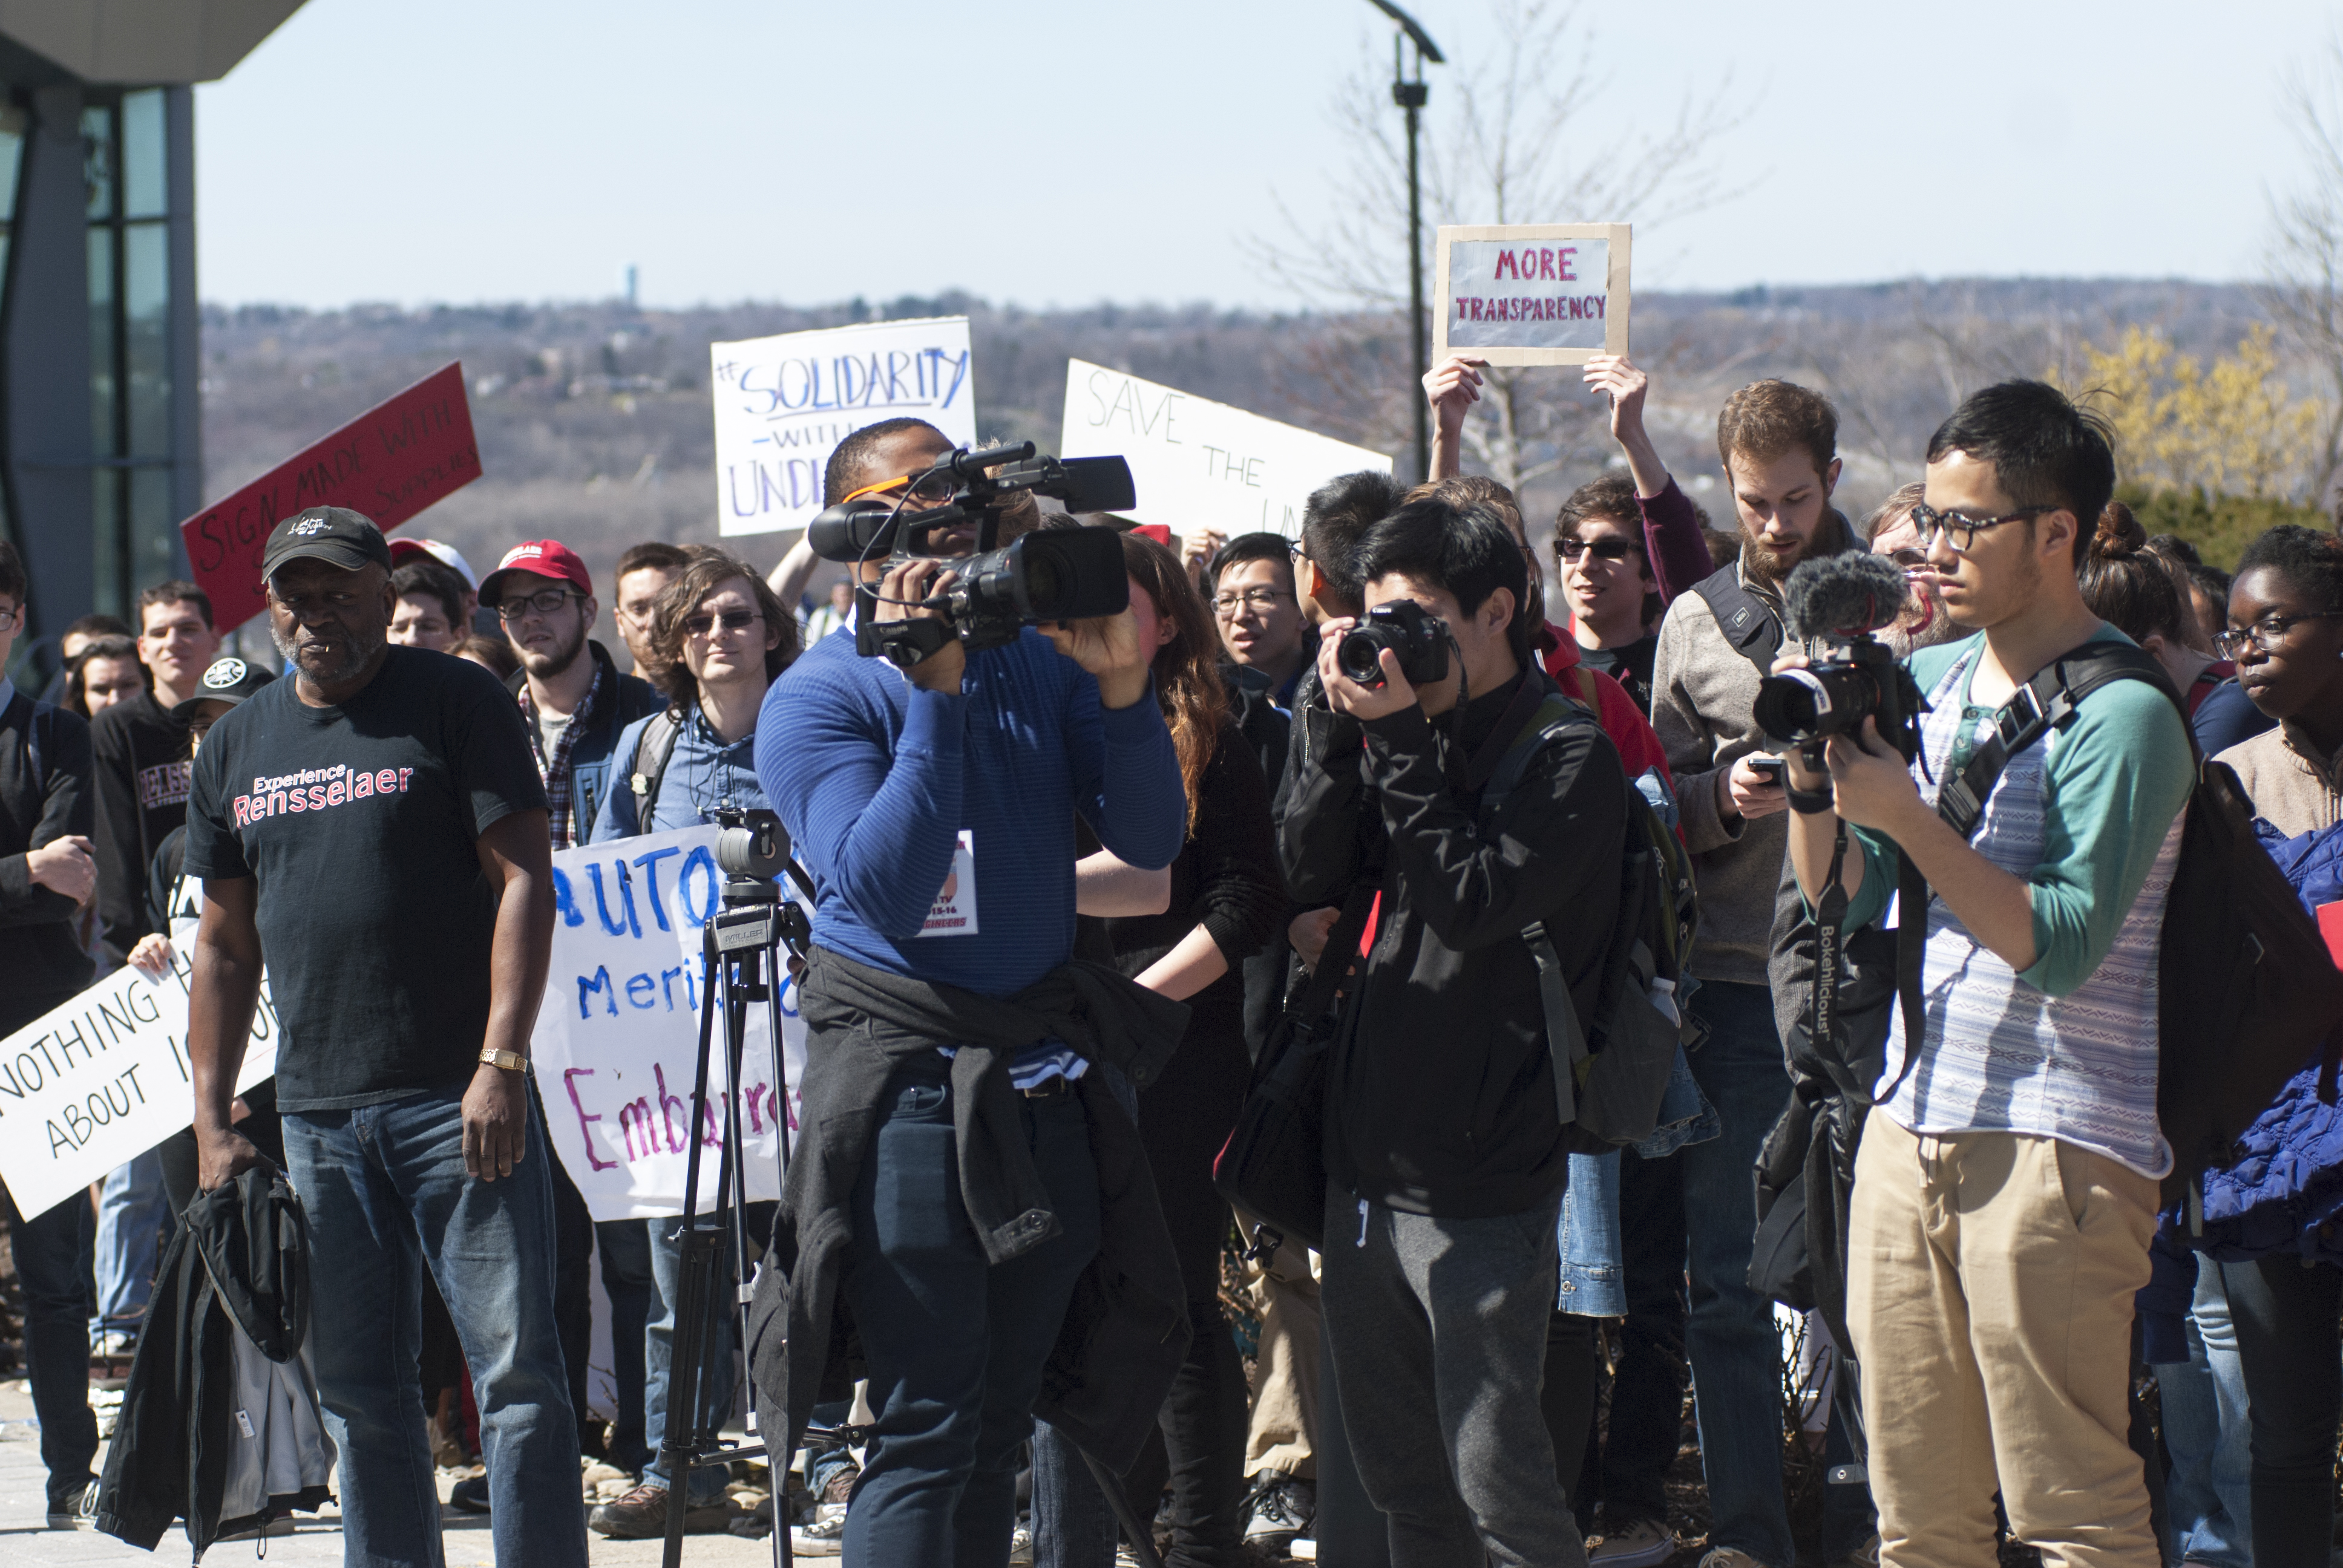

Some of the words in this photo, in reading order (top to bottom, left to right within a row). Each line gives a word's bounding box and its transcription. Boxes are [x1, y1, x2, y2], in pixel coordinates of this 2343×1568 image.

[1495, 247, 1578, 281] MORE
[1456, 295, 1606, 322] TRANSPARENCY
[1089, 370, 1185, 444] SAVE
[199, 486, 278, 572] SIGN
[295, 438, 369, 511] MADE
[378, 398, 451, 456] WITH
[374, 445, 479, 518] SUPPLIES
[1202, 445, 1265, 488] THE
[234, 768, 413, 829] Rensselaer
[254, 764, 346, 794] Experience
[552, 845, 799, 939] AUTO
[923, 916, 967, 929] GINEERS
[0, 980, 160, 1117] NOTHING
[45, 1063, 145, 1159] ABOUT
